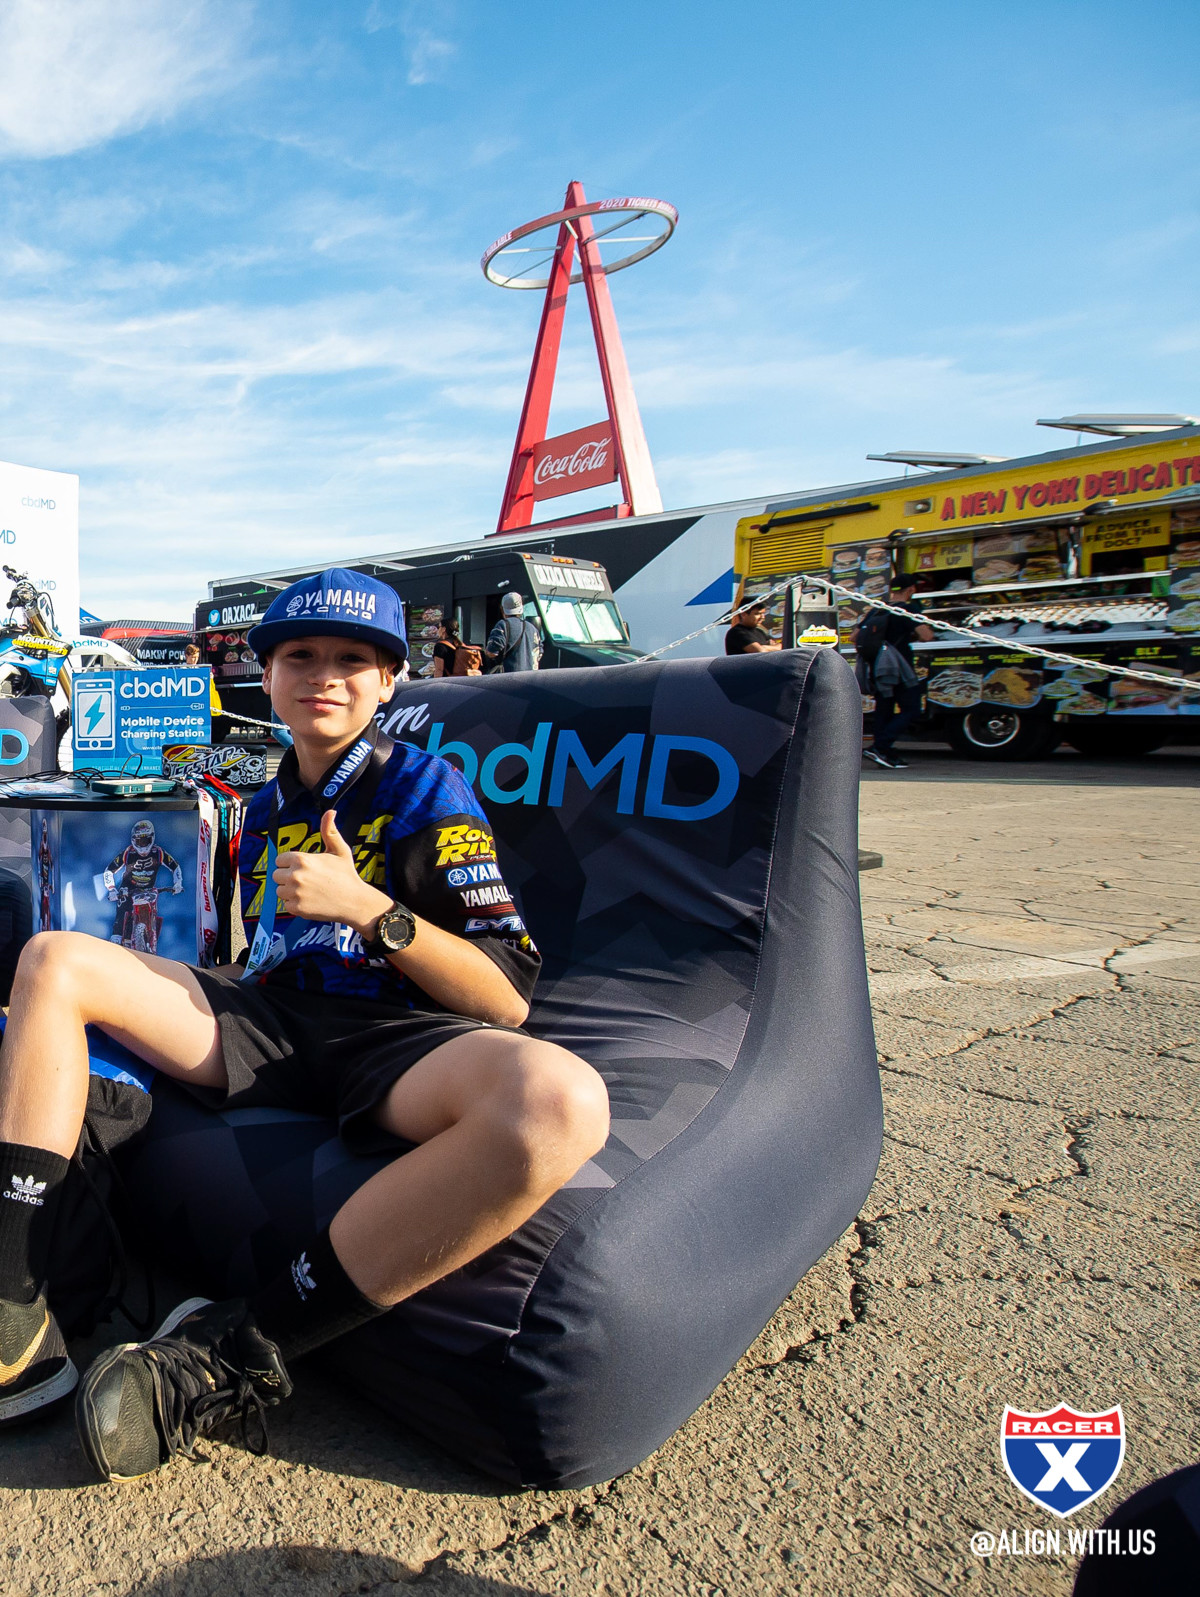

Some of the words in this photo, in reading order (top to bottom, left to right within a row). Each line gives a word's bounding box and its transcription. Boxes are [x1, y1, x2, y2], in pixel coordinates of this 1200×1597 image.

[21, 496, 56, 510] cbdMD
[940, 497, 956, 520] A
[960, 489, 1007, 518] NEW
[1012, 476, 1081, 510] YORK
[1086, 531, 1128, 542] FROM
[1133, 526, 1161, 536] THE
[33, 579, 57, 590] dMD
[305, 588, 376, 614] YAMAHA
[287, 606, 373, 620] RACING
[169, 650, 187, 660] POW
[119, 676, 205, 699] cbdMD
[121, 715, 160, 727] Mobile
[163, 715, 205, 726] Device
[121, 730, 166, 740] Charging
[168, 729, 205, 739] Station
[331, 740, 374, 784] YAMAHA
[405, 722, 740, 821] bdMD
[467, 863, 502, 882] YAM
[465, 915, 526, 932] GYT
[3, 1190, 44, 1206] adidas
